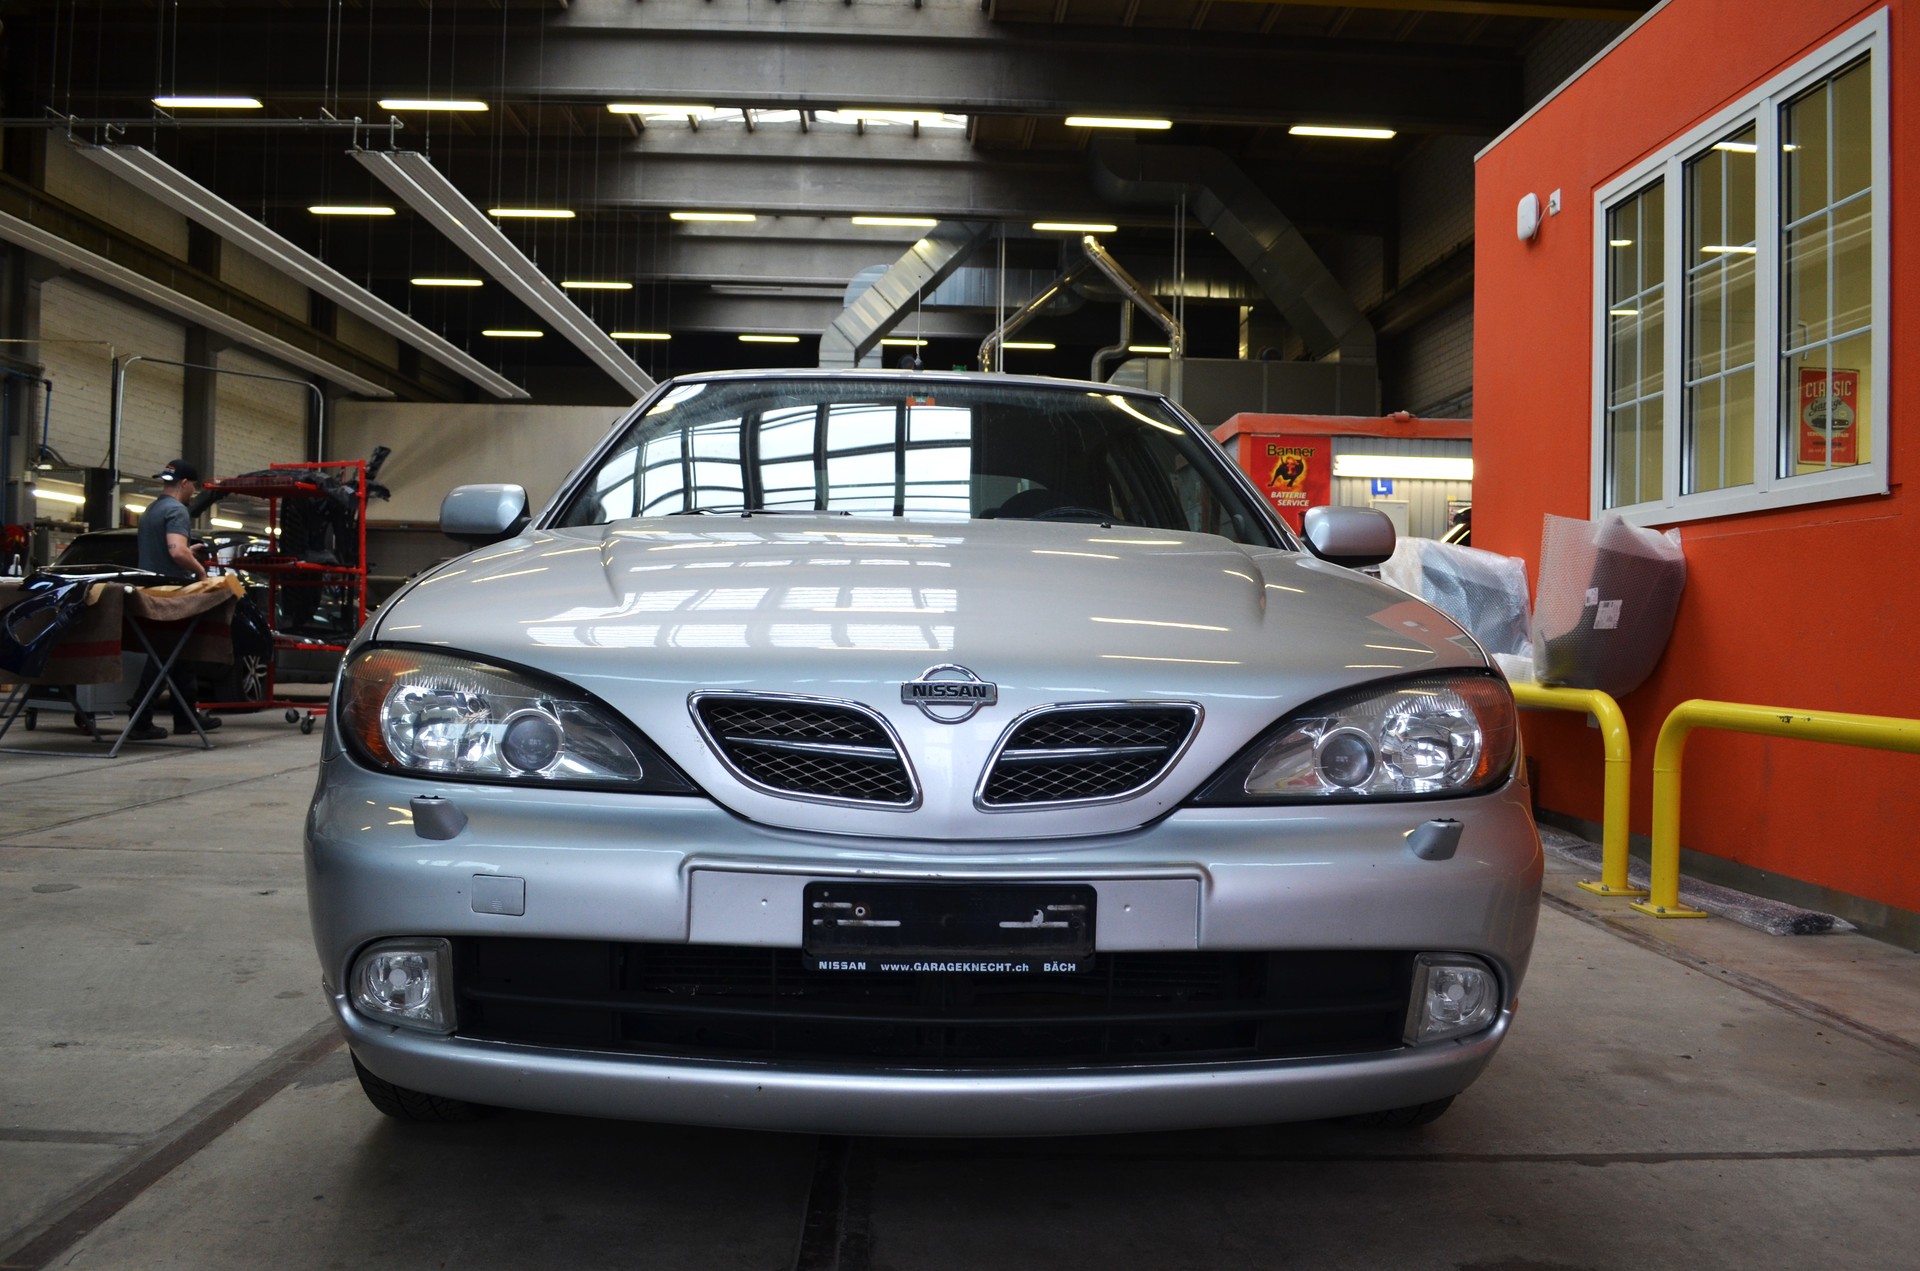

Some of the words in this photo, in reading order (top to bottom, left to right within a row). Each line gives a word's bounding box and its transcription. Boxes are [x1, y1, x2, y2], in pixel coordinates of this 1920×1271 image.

[1805, 380, 1852, 398] CLASIC
[1808, 398, 1844, 416] Garge
[1267, 443, 1315, 457] Banner
[1376, 478, 1388, 492] L
[1270, 491, 1307, 499] BATTERIE
[1277, 499, 1310, 507] SERVICE
[912, 684, 987, 698] NISSAN
[818, 960, 867, 971] NISSAN
[880, 961, 1030, 973] www.GARAGEKNECHT.ch
[1043, 960, 1077, 973] BÄCH
